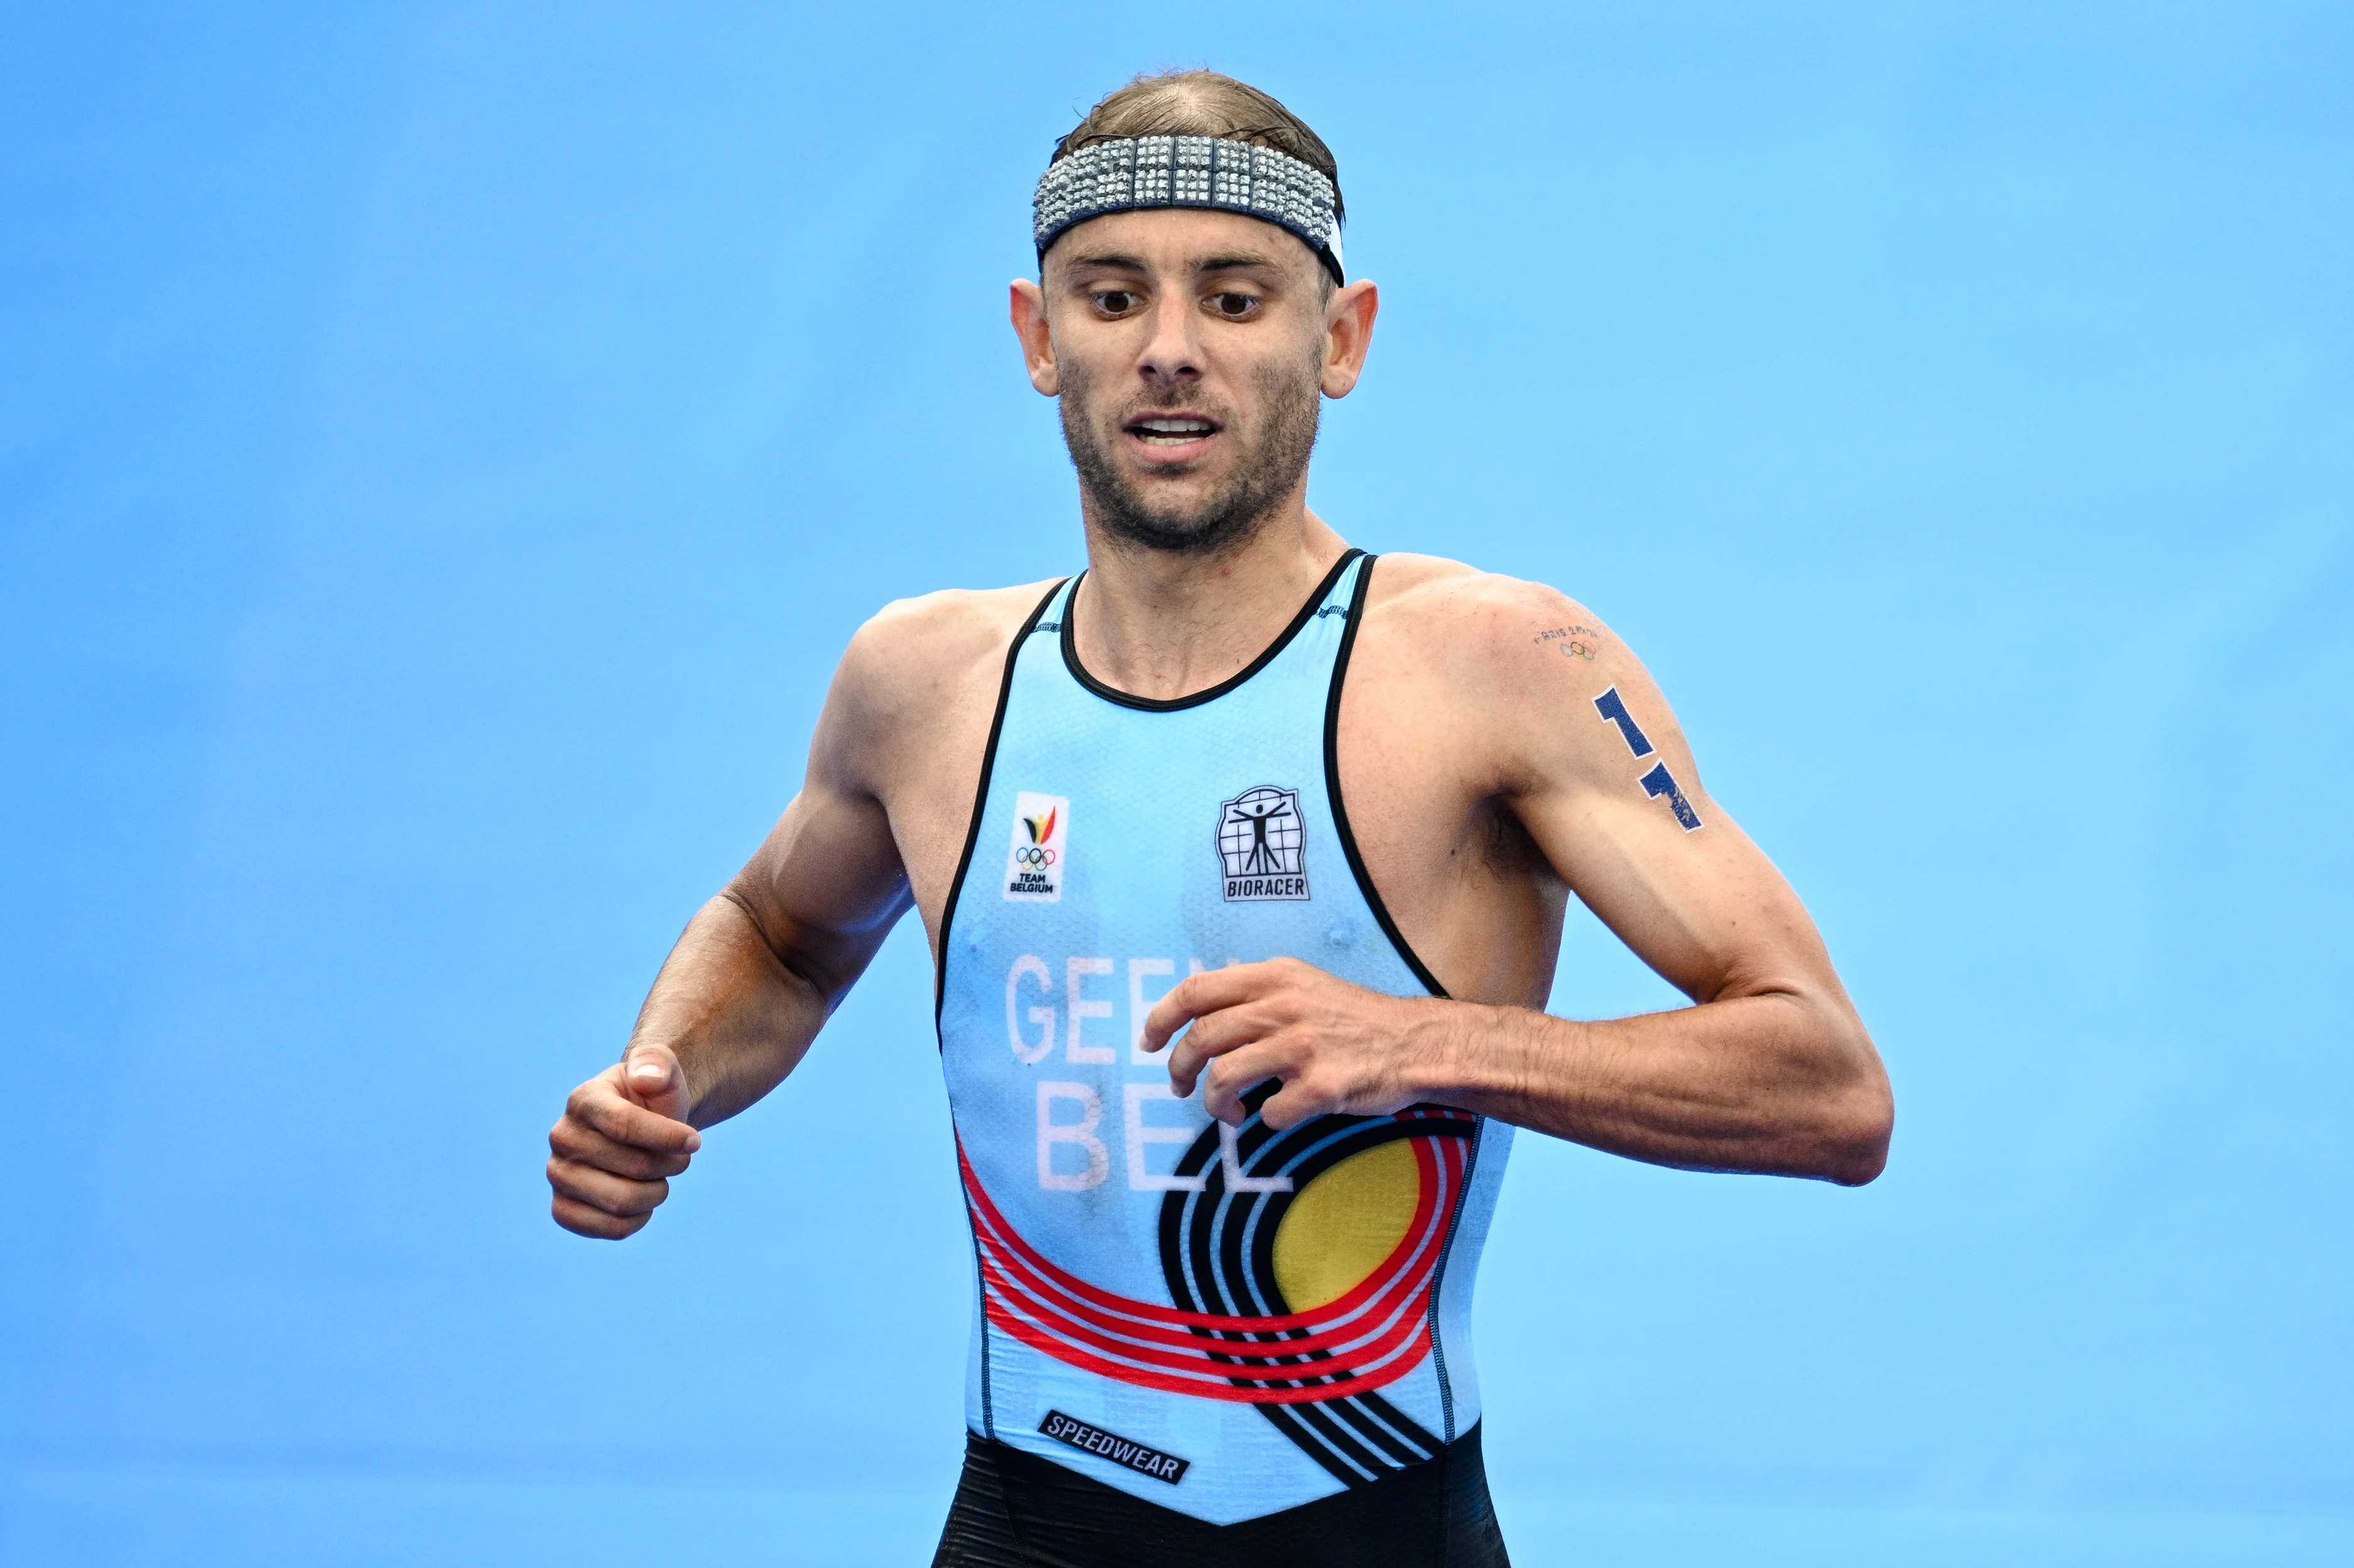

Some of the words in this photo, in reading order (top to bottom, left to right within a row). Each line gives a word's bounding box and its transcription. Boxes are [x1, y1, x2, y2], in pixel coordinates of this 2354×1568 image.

[1009, 882, 1053, 893] BELGIUM
[1020, 873, 1046, 883] TEAM
[1227, 878, 1304, 897] BIORACER
[1006, 954, 1240, 1065] GEE
[1036, 1081, 1294, 1192] BEL
[1047, 1416, 1179, 1479] SPEEDWEAR
